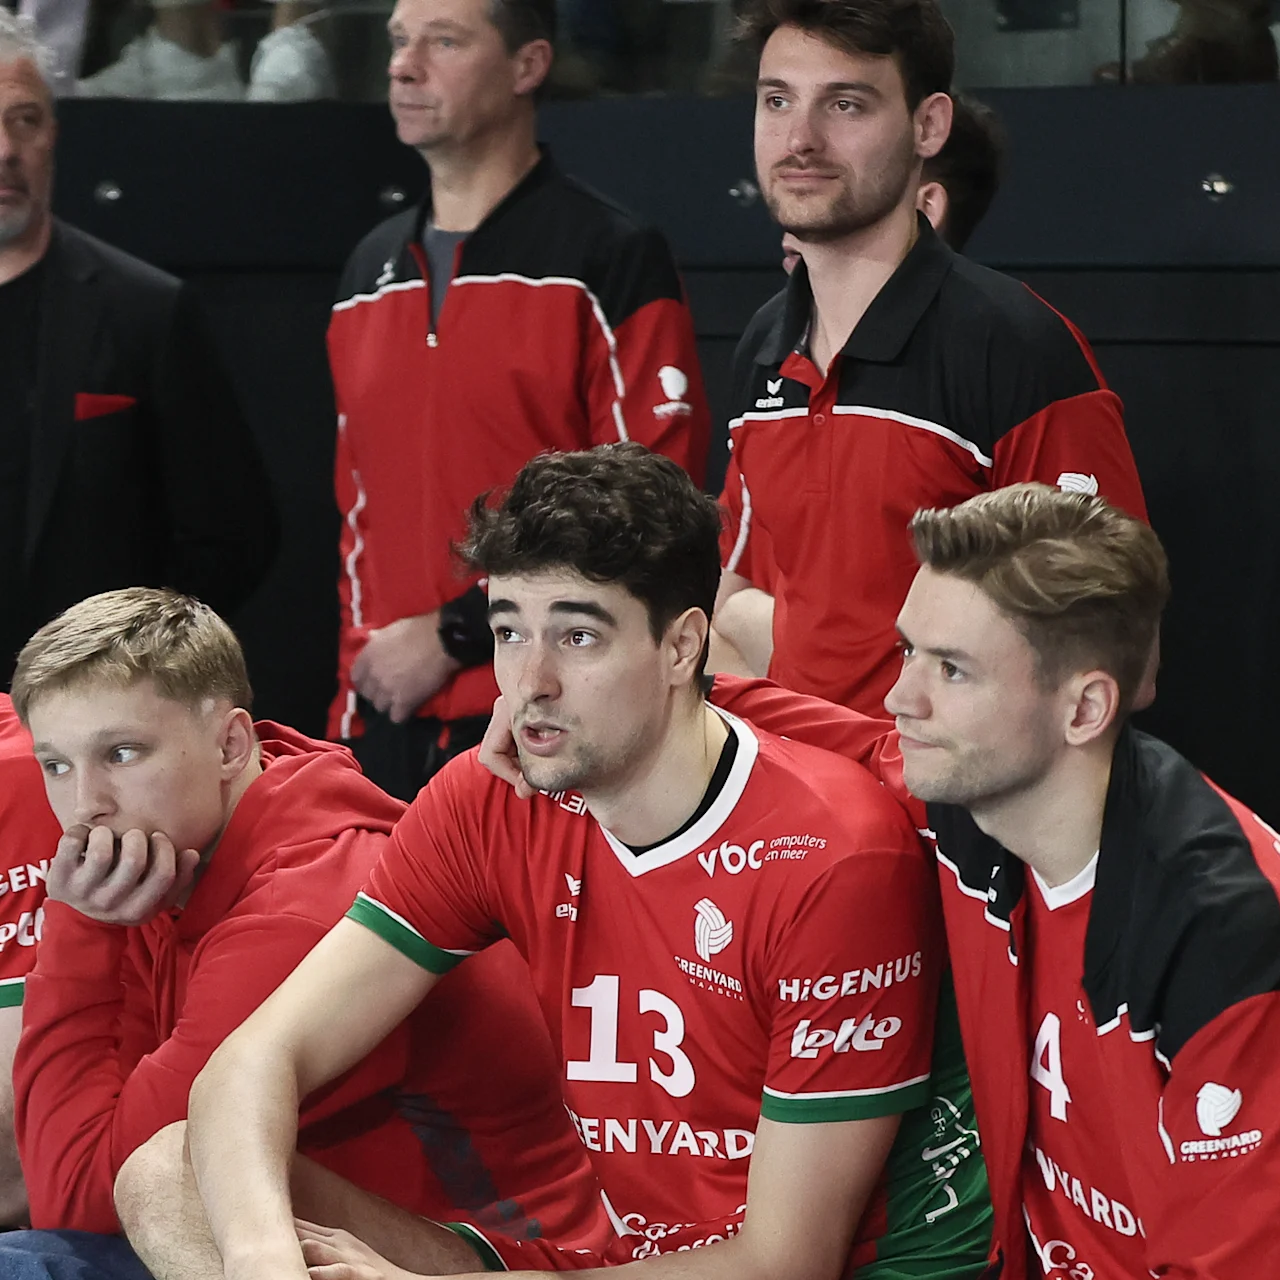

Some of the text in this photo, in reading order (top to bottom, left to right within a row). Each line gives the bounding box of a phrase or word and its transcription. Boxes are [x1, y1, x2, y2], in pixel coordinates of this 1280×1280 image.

[697, 833, 827, 879] vbc computers
[779, 848, 809, 861] meer
[566, 973, 697, 1099] 13
[1180, 1129, 1263, 1155] GREENYARD
